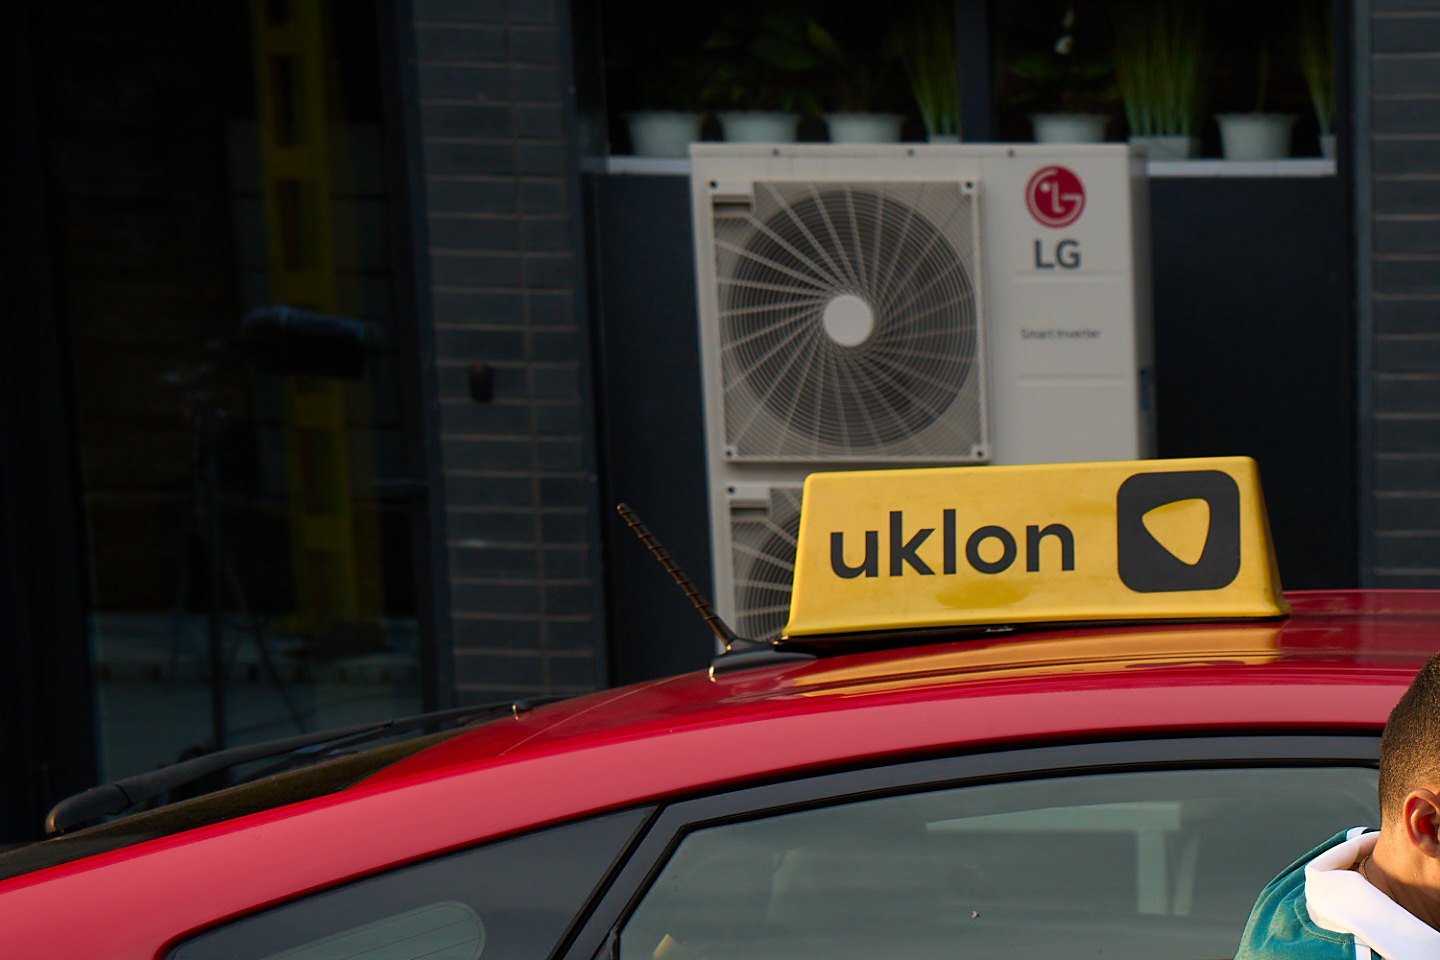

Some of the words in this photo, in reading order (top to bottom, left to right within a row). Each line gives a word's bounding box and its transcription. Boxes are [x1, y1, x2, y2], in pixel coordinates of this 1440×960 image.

[1034, 239, 1082, 270] LG
[1021, 328, 1054, 340] Smart
[829, 508, 1076, 580] uklon
